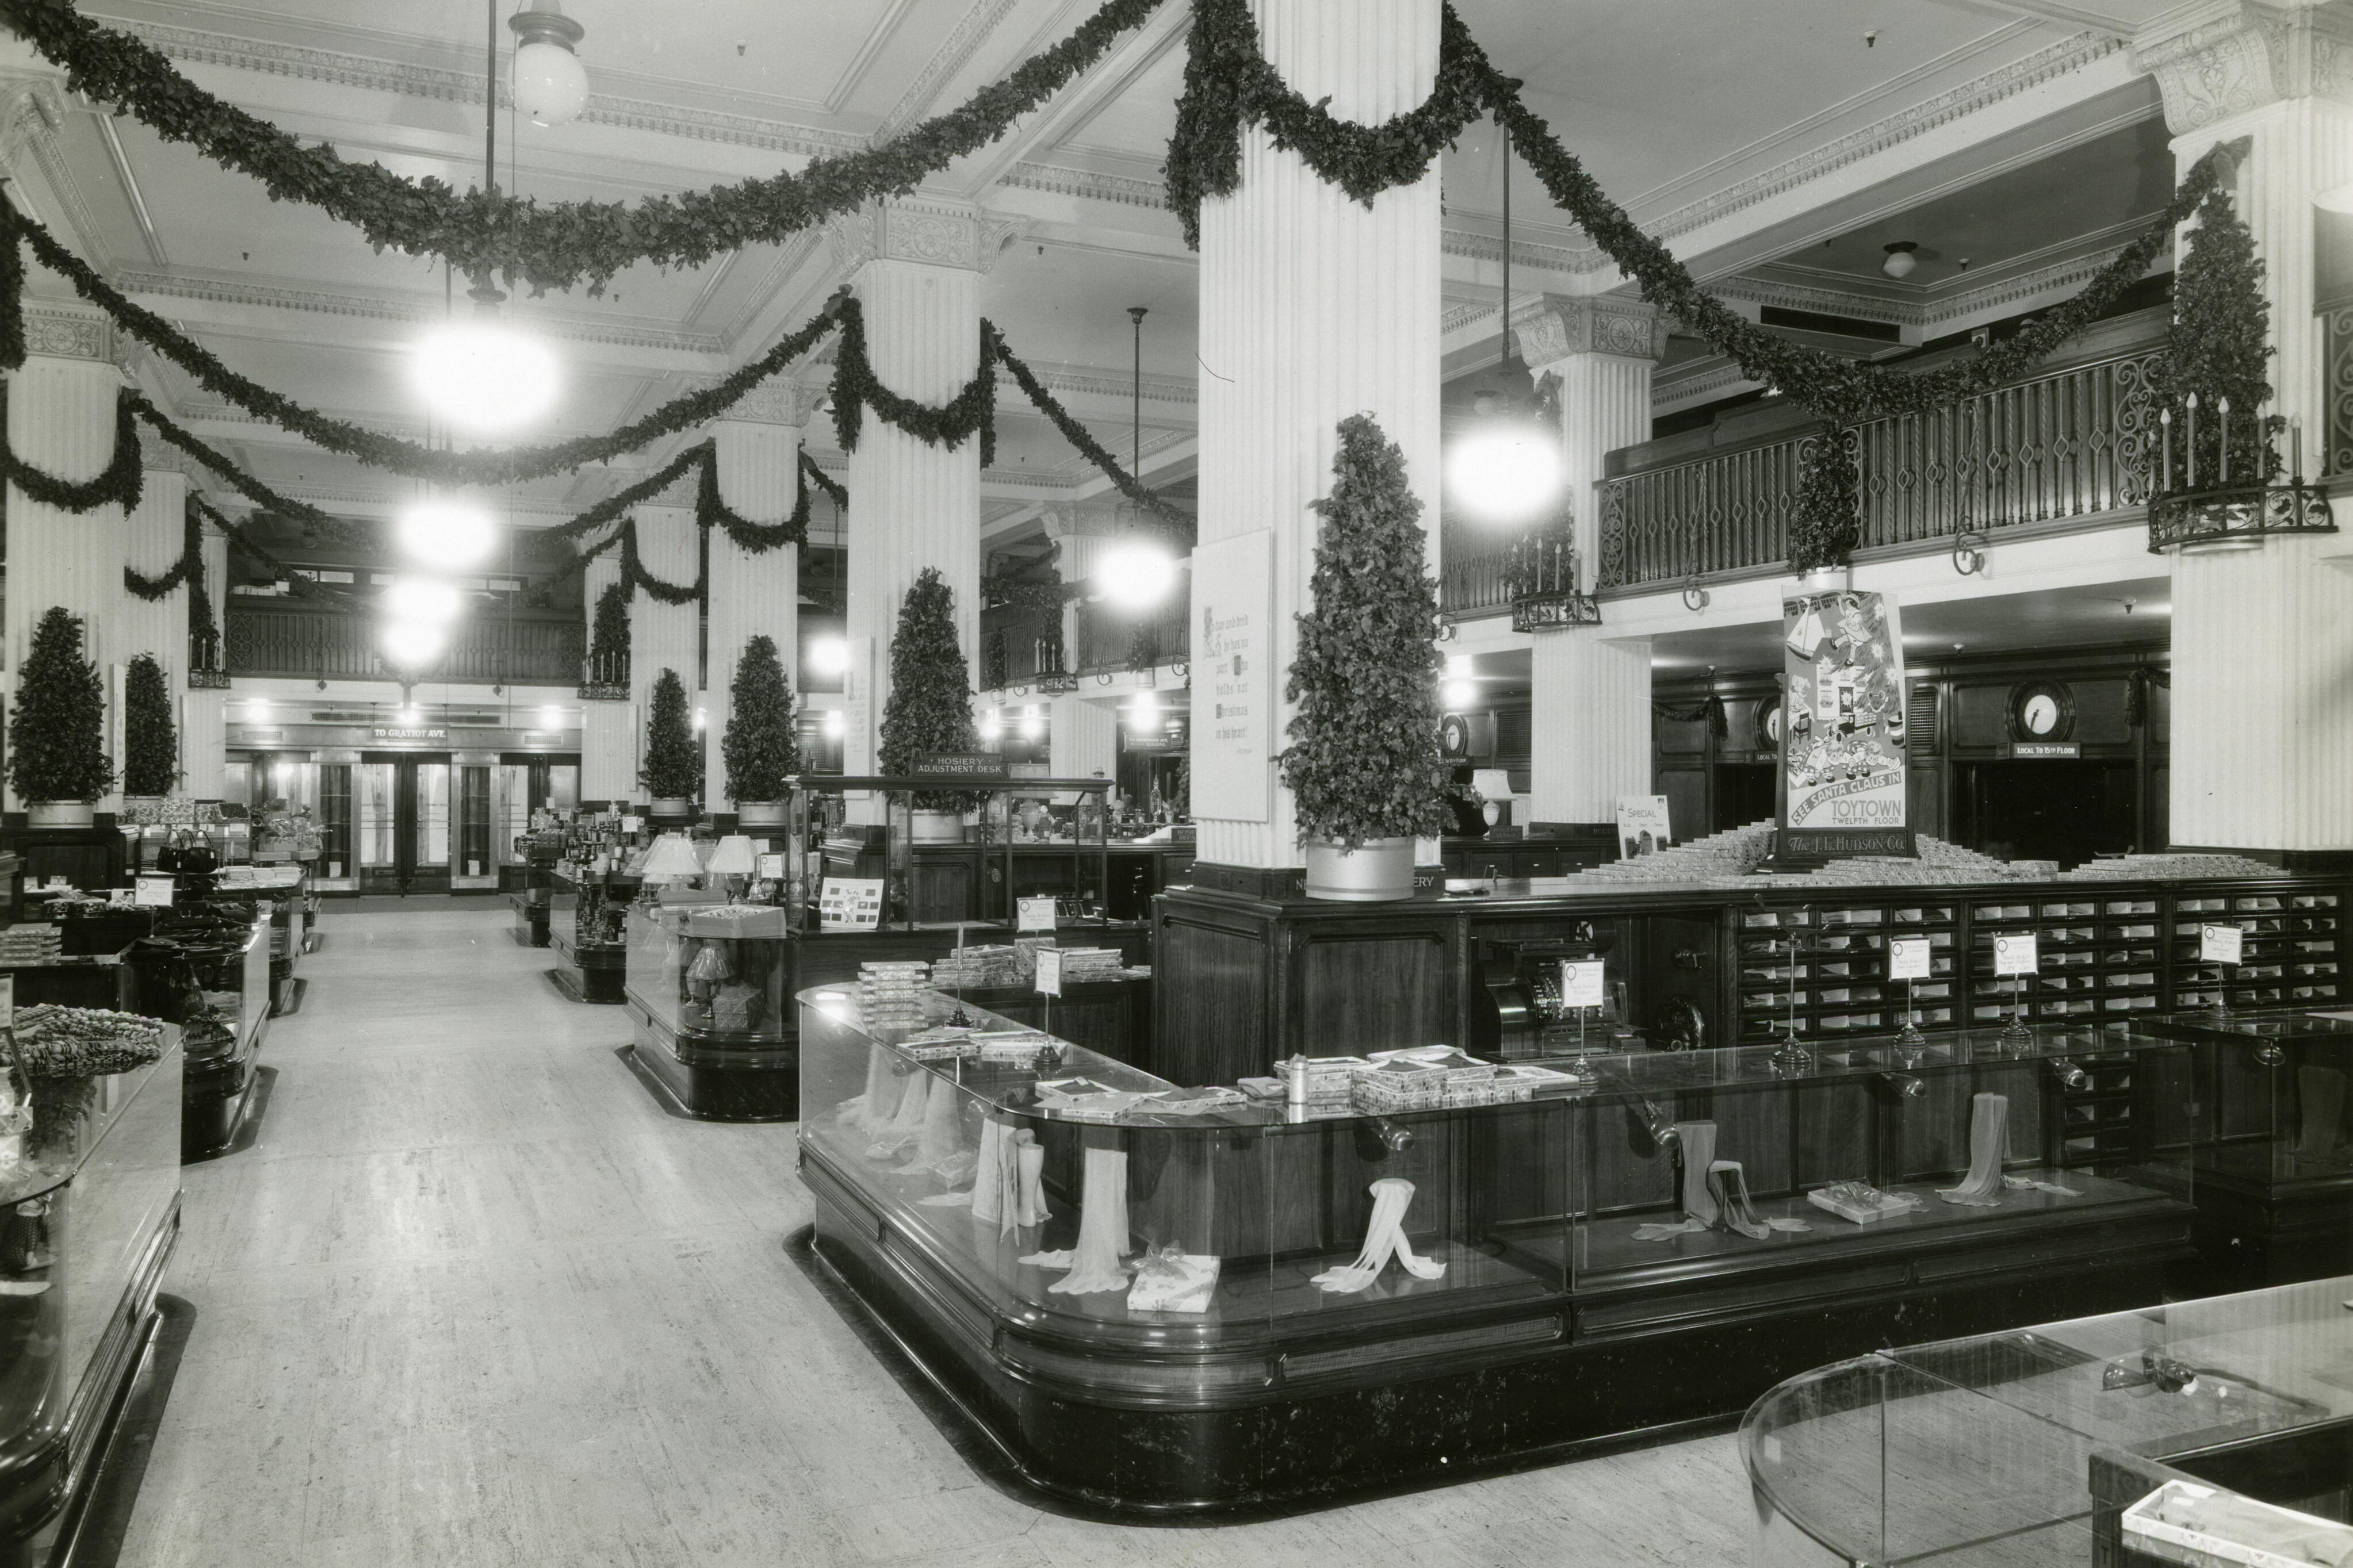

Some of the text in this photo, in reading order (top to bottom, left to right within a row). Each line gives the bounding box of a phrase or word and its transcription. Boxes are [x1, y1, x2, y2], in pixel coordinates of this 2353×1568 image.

[388, 729, 427, 738] GRATIOT
[427, 730, 446, 738] AVE.
[918, 765, 1002, 773] ADJUSTMENT DESK
[1792, 772, 1900, 825] SEE SANTA CLAUS IN
[1628, 808, 1657, 818] SPECIAL
[1831, 800, 1901, 816] TOYTOWN
[1788, 837, 1809, 852] The
